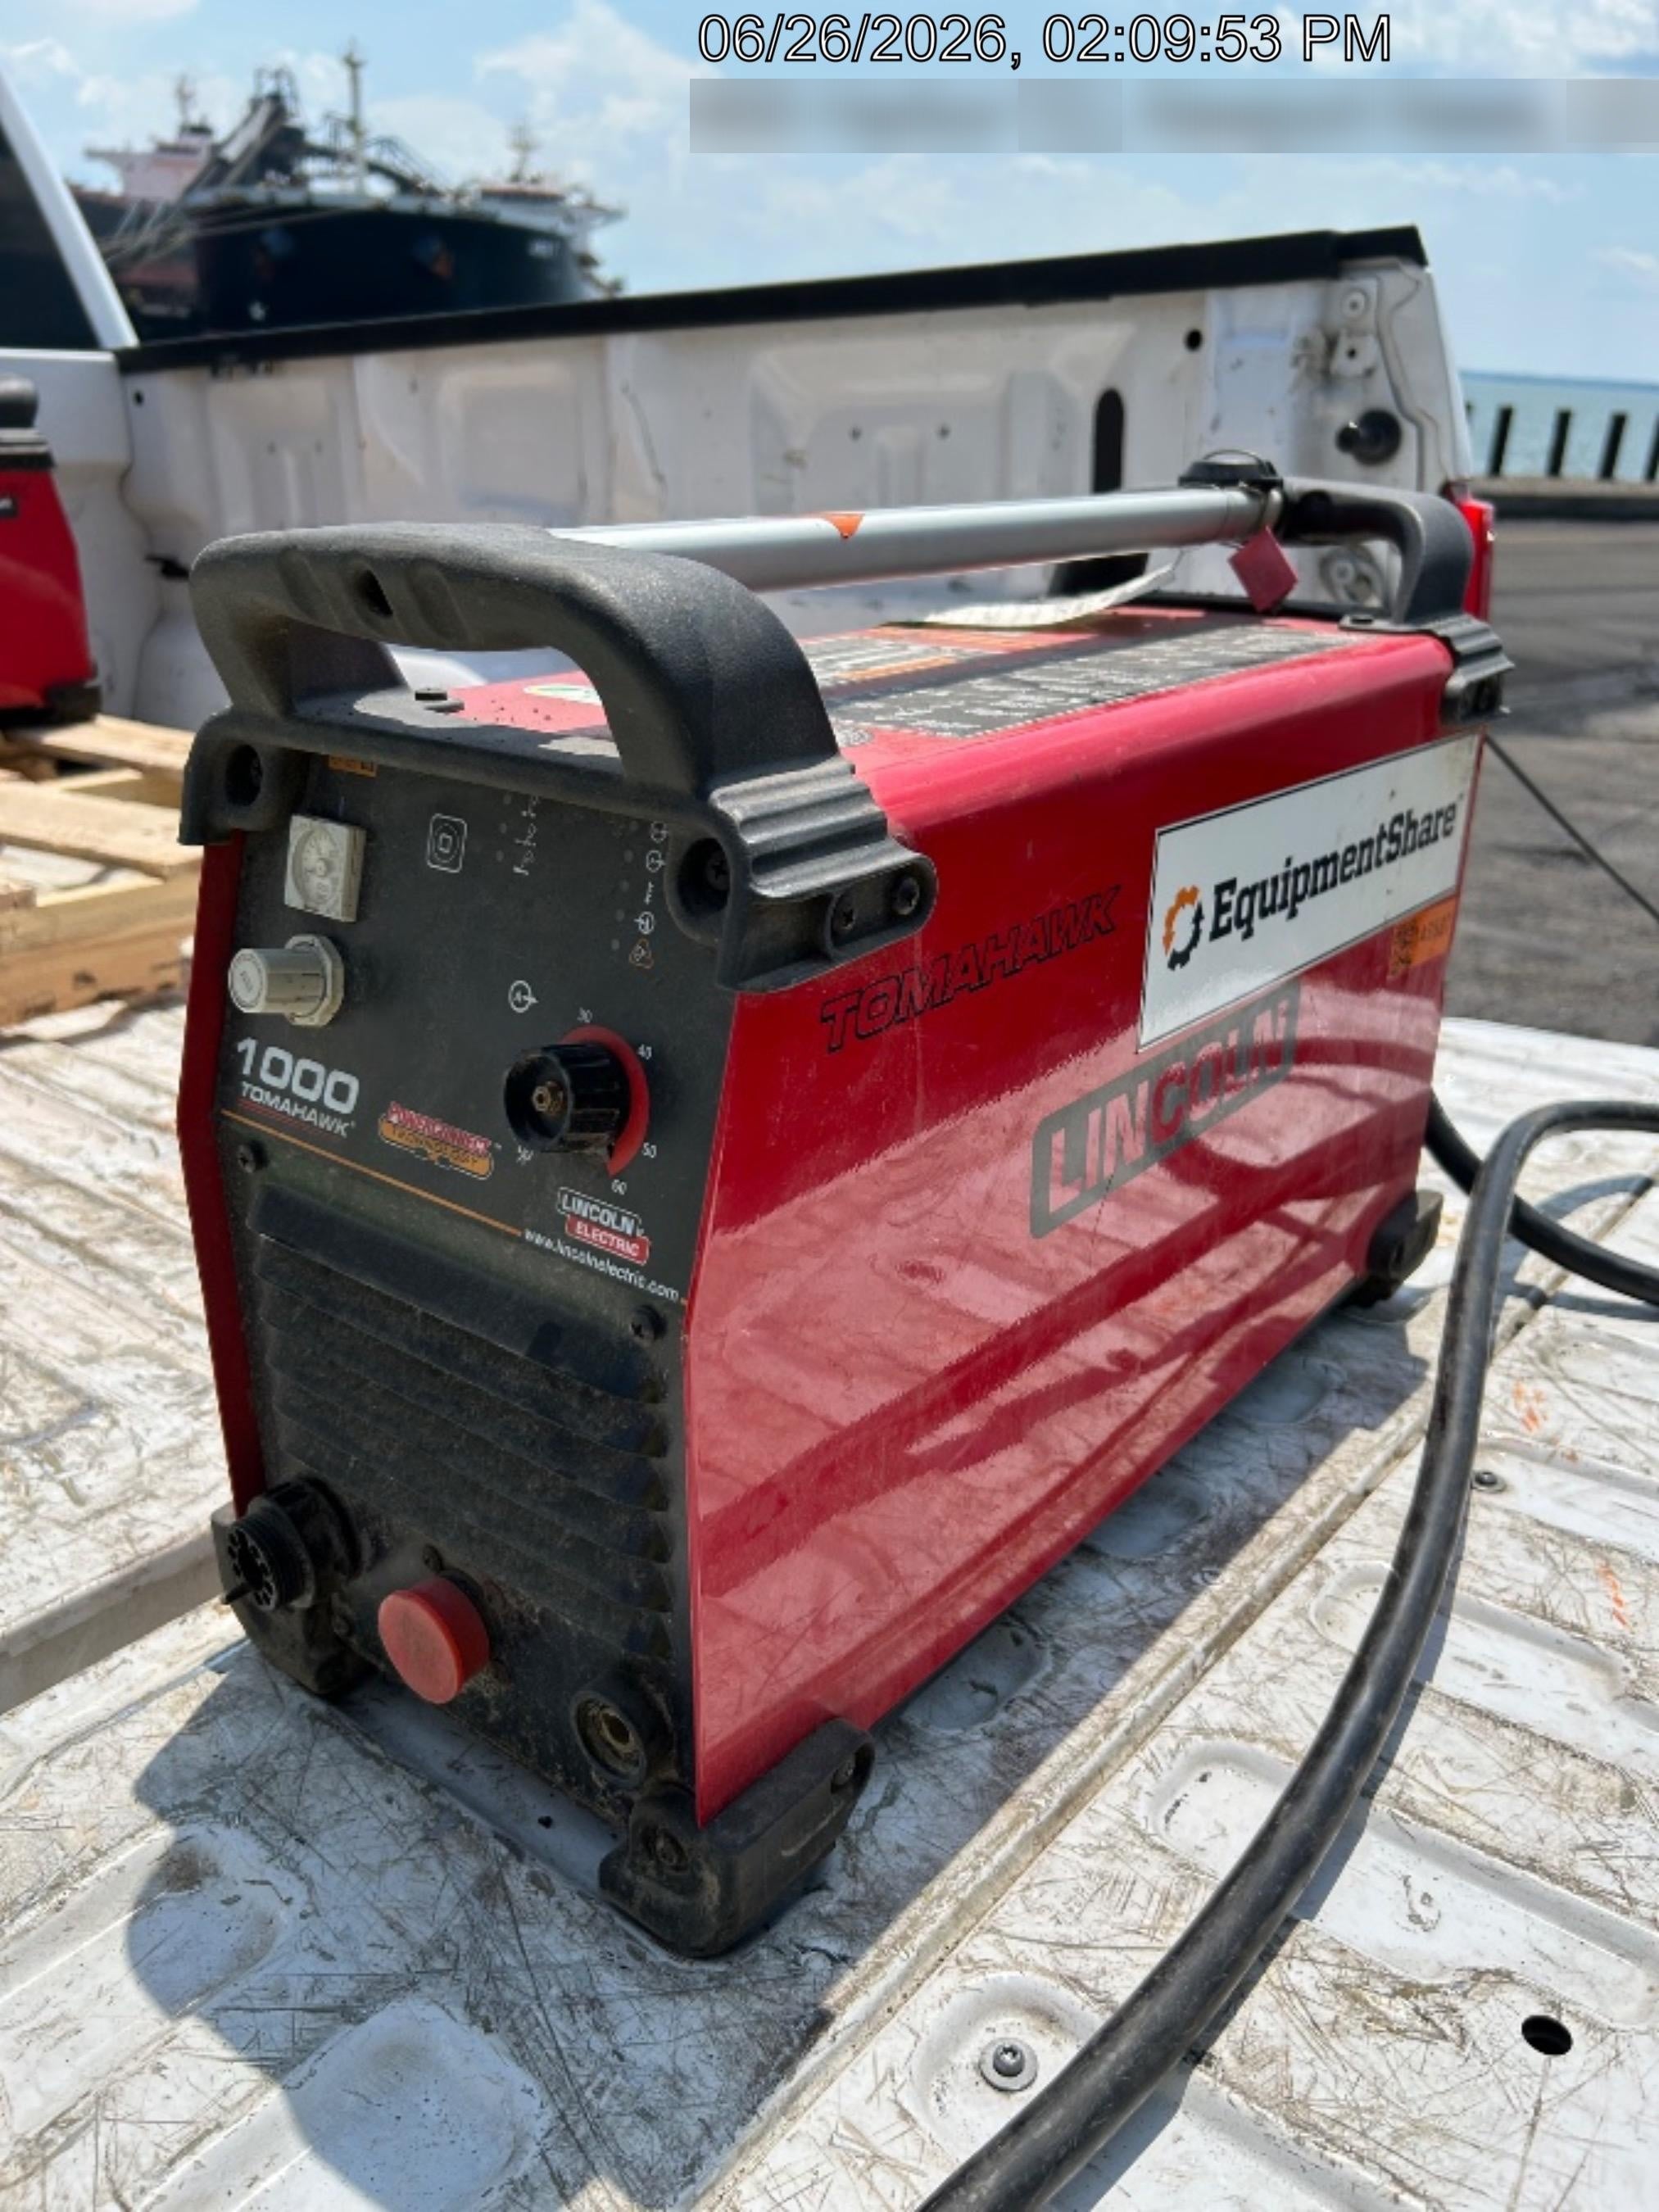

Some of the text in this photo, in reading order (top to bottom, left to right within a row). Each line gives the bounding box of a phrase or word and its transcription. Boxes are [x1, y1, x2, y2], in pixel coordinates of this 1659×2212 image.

[1208, 802, 1457, 942] EquipmentShare
[820, 884, 1122, 1054] TOMAHAWK
[237, 1036, 360, 1114] 1000
[241, 1080, 351, 1139] TOMAHAWK
[1047, 996, 1289, 1216] LINCOLN
[561, 1193, 635, 1236] LINCOLN
[575, 1220, 640, 1258] ELECTRIC
